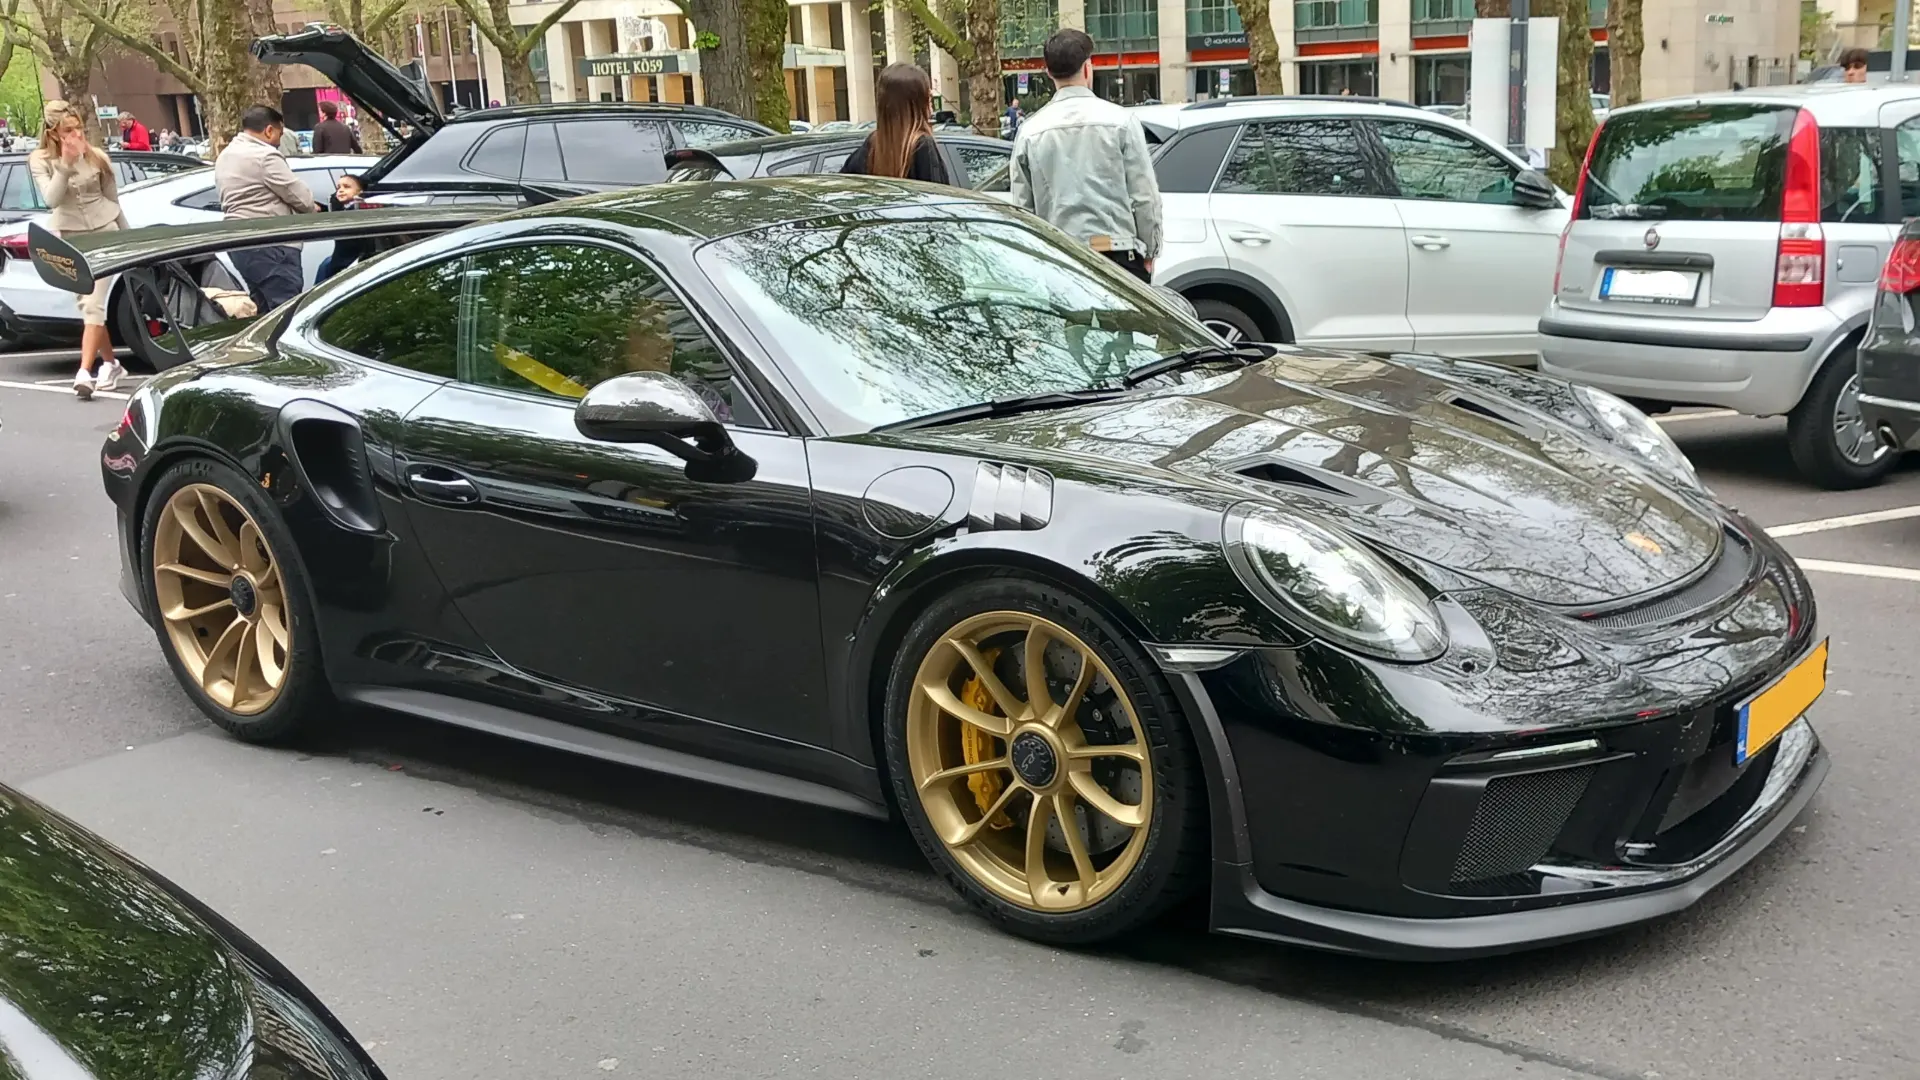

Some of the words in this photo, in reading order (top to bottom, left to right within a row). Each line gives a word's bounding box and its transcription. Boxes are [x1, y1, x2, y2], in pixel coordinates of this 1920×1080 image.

[592, 62, 630, 75] HOTEL
[633, 58, 663, 73] KÖ59
[1080, 616, 1169, 750] MICHELIN
